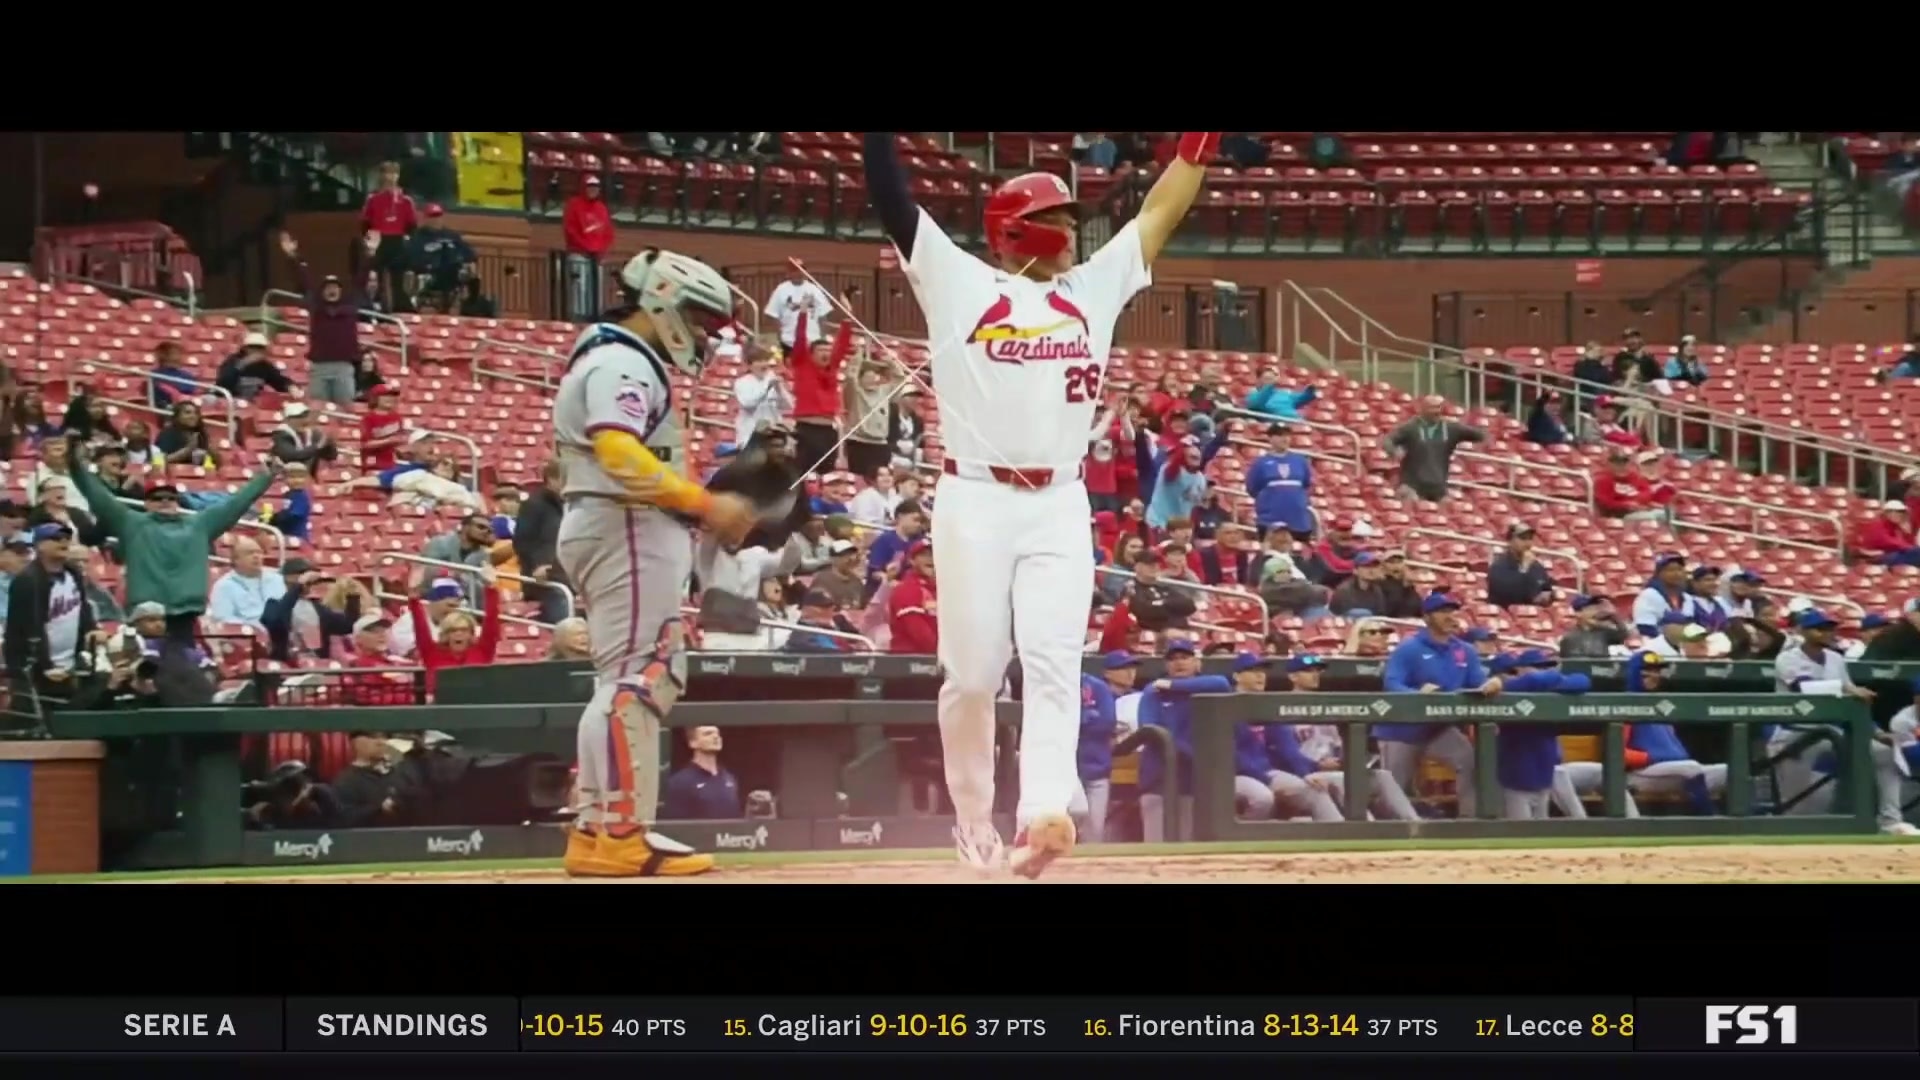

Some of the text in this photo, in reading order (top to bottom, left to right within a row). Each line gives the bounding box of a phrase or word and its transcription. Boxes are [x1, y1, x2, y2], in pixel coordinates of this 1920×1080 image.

[985, 324, 1093, 366] Cardinals
[1064, 364, 1101, 403] 26
[1279, 705, 1371, 716] BANK OF AMERICA
[1425, 705, 1516, 716] BANK OF AMERICA
[274, 840, 319, 860] Mercy
[427, 836, 471, 855] Mercy
[716, 832, 757, 850] Mercy
